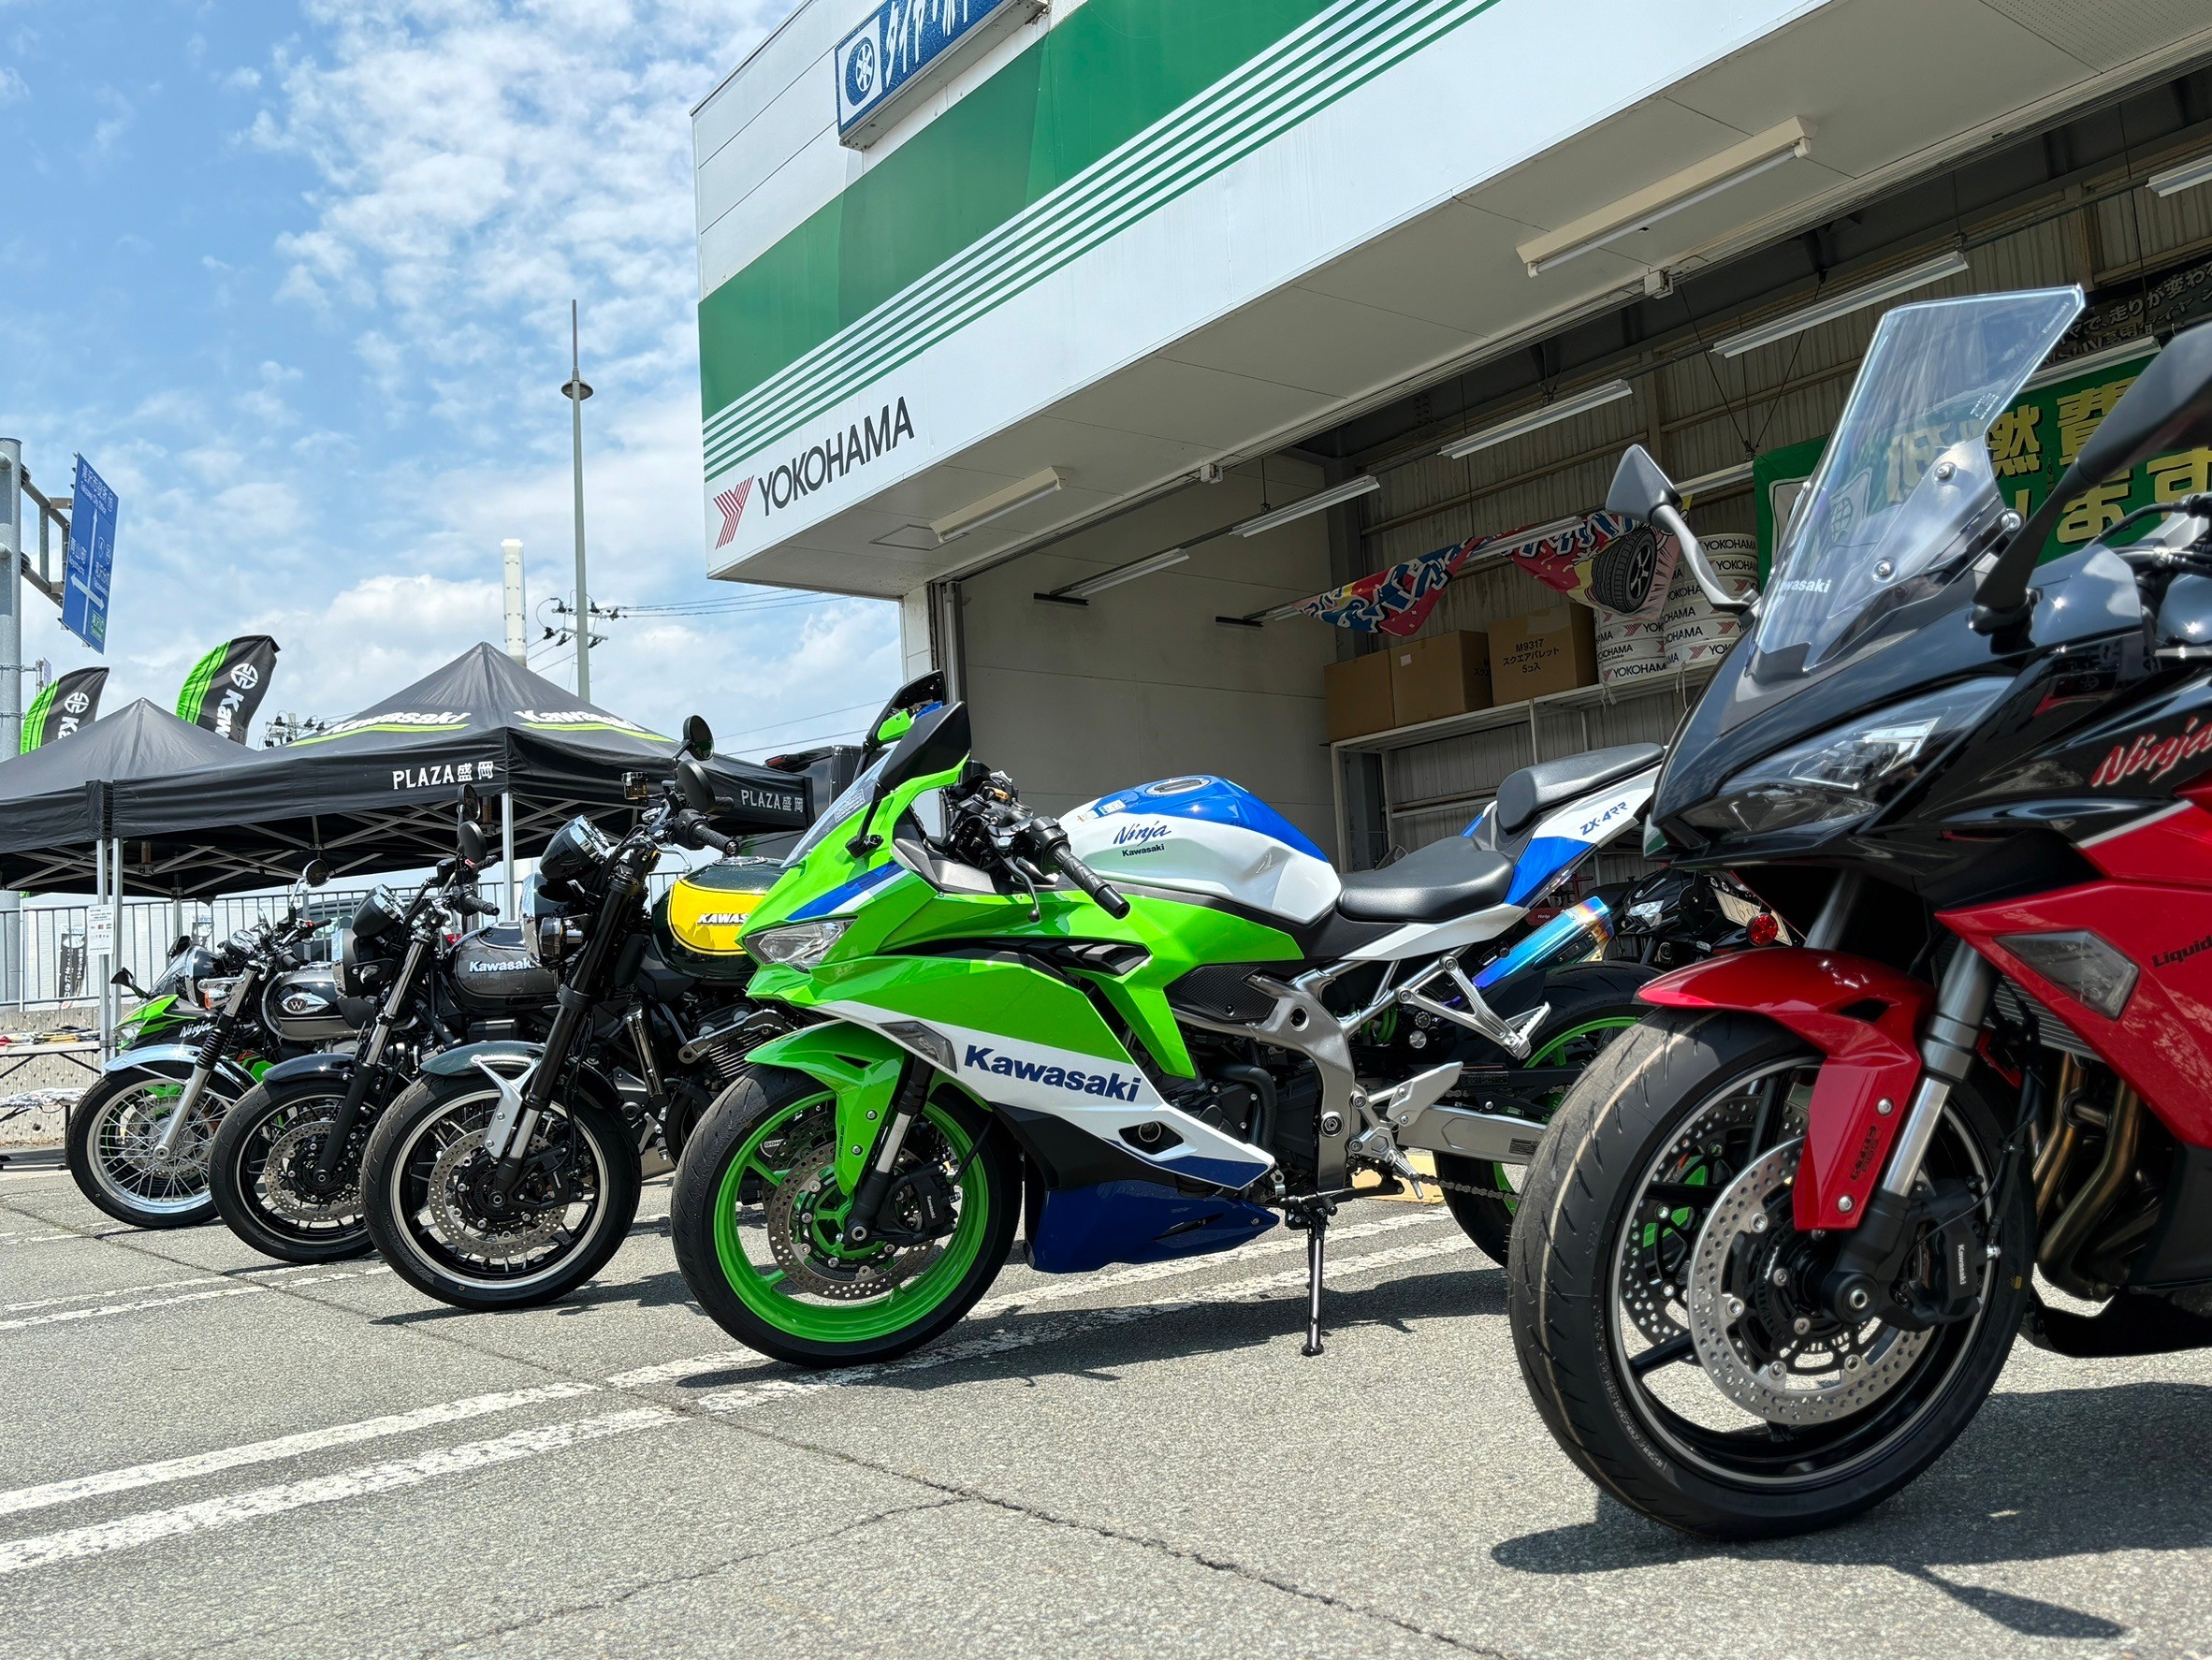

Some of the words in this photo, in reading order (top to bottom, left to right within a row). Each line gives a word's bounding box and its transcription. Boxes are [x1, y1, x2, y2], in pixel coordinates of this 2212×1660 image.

[758, 396, 915, 517] YOKOHAMA
[1703, 538, 1757, 551] YOKOHAMA
[1516, 638, 1544, 653] M9317
[320, 711, 472, 736] Kawasaki
[513, 709, 646, 732] Kawasaki
[2089, 716, 2212, 788] Ninja
[1113, 820, 1172, 848] Ninja
[1122, 843, 1165, 857] Kawasaki
[290, 1000, 304, 1011] W
[179, 1021, 214, 1039] Ninja
[964, 1044, 1142, 1102] Kawasaki
[1957, 1244, 1967, 1286] Kawasaki
